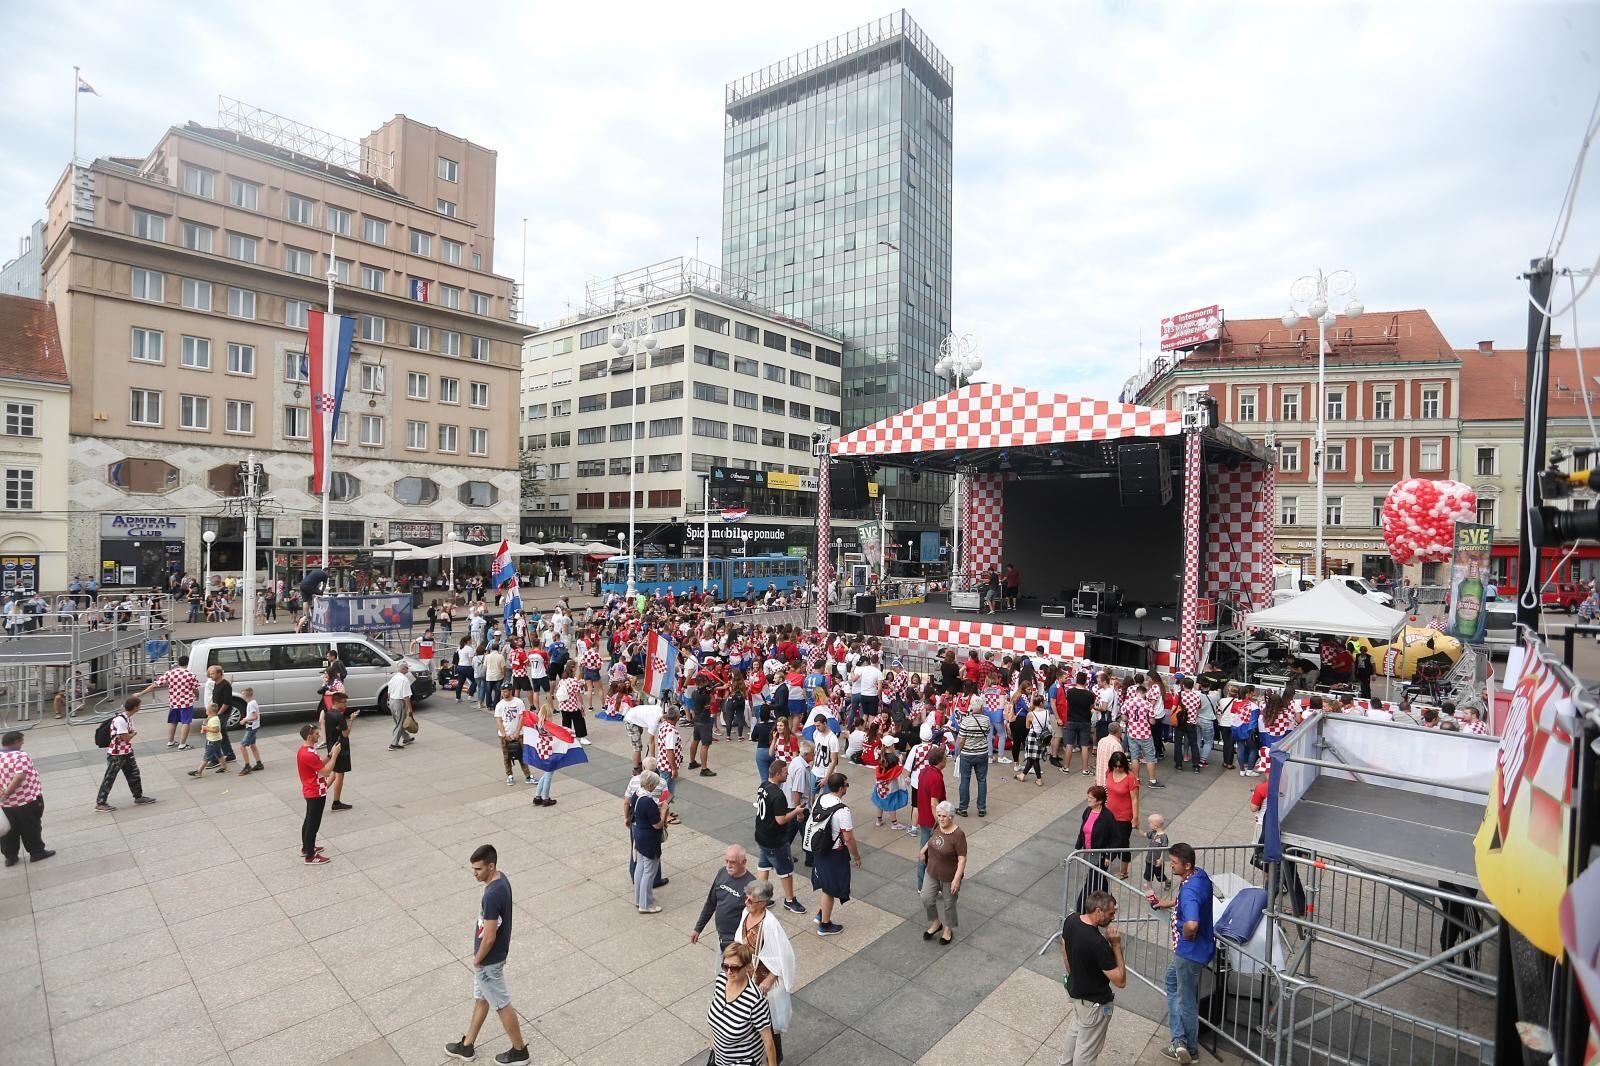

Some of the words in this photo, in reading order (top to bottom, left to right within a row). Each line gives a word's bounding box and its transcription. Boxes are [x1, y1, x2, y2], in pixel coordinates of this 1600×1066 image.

[1178, 308, 1214, 322] Internorm
[112, 516, 176, 526] ADMIRAL
[128, 527, 162, 537] CLUB
[711, 527, 754, 539] mobilne
[754, 528, 785, 541] ponude
[1459, 528, 1489, 545] SVE
[1297, 541, 1329, 549] ANĆ
[1338, 541, 1386, 550] HOLDIN
[349, 599, 399, 624] HRT
[807, 676, 817, 688] 11
